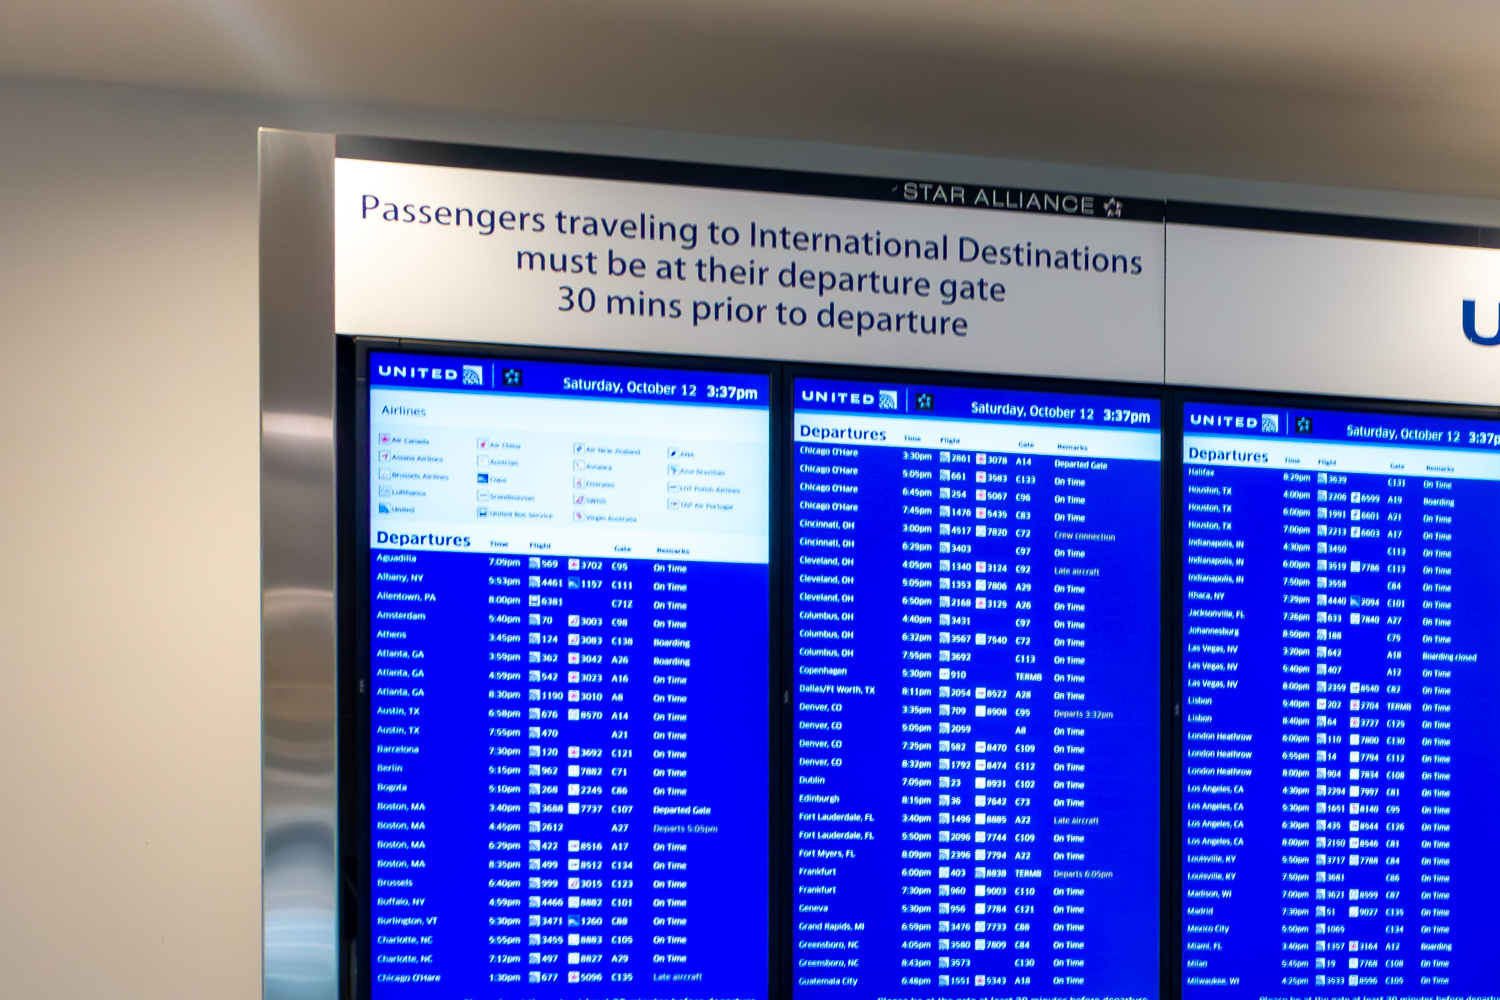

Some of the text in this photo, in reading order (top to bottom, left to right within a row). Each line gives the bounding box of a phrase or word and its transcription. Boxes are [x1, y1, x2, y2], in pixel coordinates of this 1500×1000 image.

[902, 183, 1094, 219] STAR ALLIANCE
[360, 194, 1141, 273] Passengers traveling to International Destinations
[517, 249, 1005, 304] must be at their departure gate
[559, 286, 967, 335] 30 mins prior to departure
[378, 365, 458, 380] UNITED
[563, 377, 758, 400] Saturday, October 12 3:37pm
[801, 390, 874, 404] UNITED
[381, 404, 426, 416] Airlines
[971, 401, 1150, 424] Saturday, October 12 3:37pm
[1190, 414, 1258, 428] UNITED
[799, 424, 887, 443] Departures
[939, 436, 961, 446] Flight
[1346, 424, 1398, 440] Saturday,
[1400, 427, 1443, 441] October
[1447, 430, 1460, 442] 12
[799, 445, 831, 456] Chicago
[831, 447, 858, 457] O'Hare
[987, 455, 1008, 465] 3078
[1015, 456, 1032, 466] A14
[1053, 458, 1089, 469] Departed
[1090, 460, 1108, 470] Gate
[1188, 447, 1269, 466] Departures
[1187, 484, 1221, 495] Houston,
[1221, 485, 1232, 495] TX
[1422, 496, 1455, 508] Boarding
[375, 530, 472, 549] Departures
[376, 610, 426, 620] Amsterdam
[541, 615, 553, 625] 70
[652, 618, 666, 628] On
[666, 619, 687, 629] Time
[798, 848, 815, 857] Fort
[816, 848, 844, 858] Myers,
[845, 848, 855, 858] FL
[986, 850, 1007, 860] 7794
[1014, 850, 1031, 860] A22
[1052, 851, 1065, 860] On
[1065, 851, 1085, 860] Time
